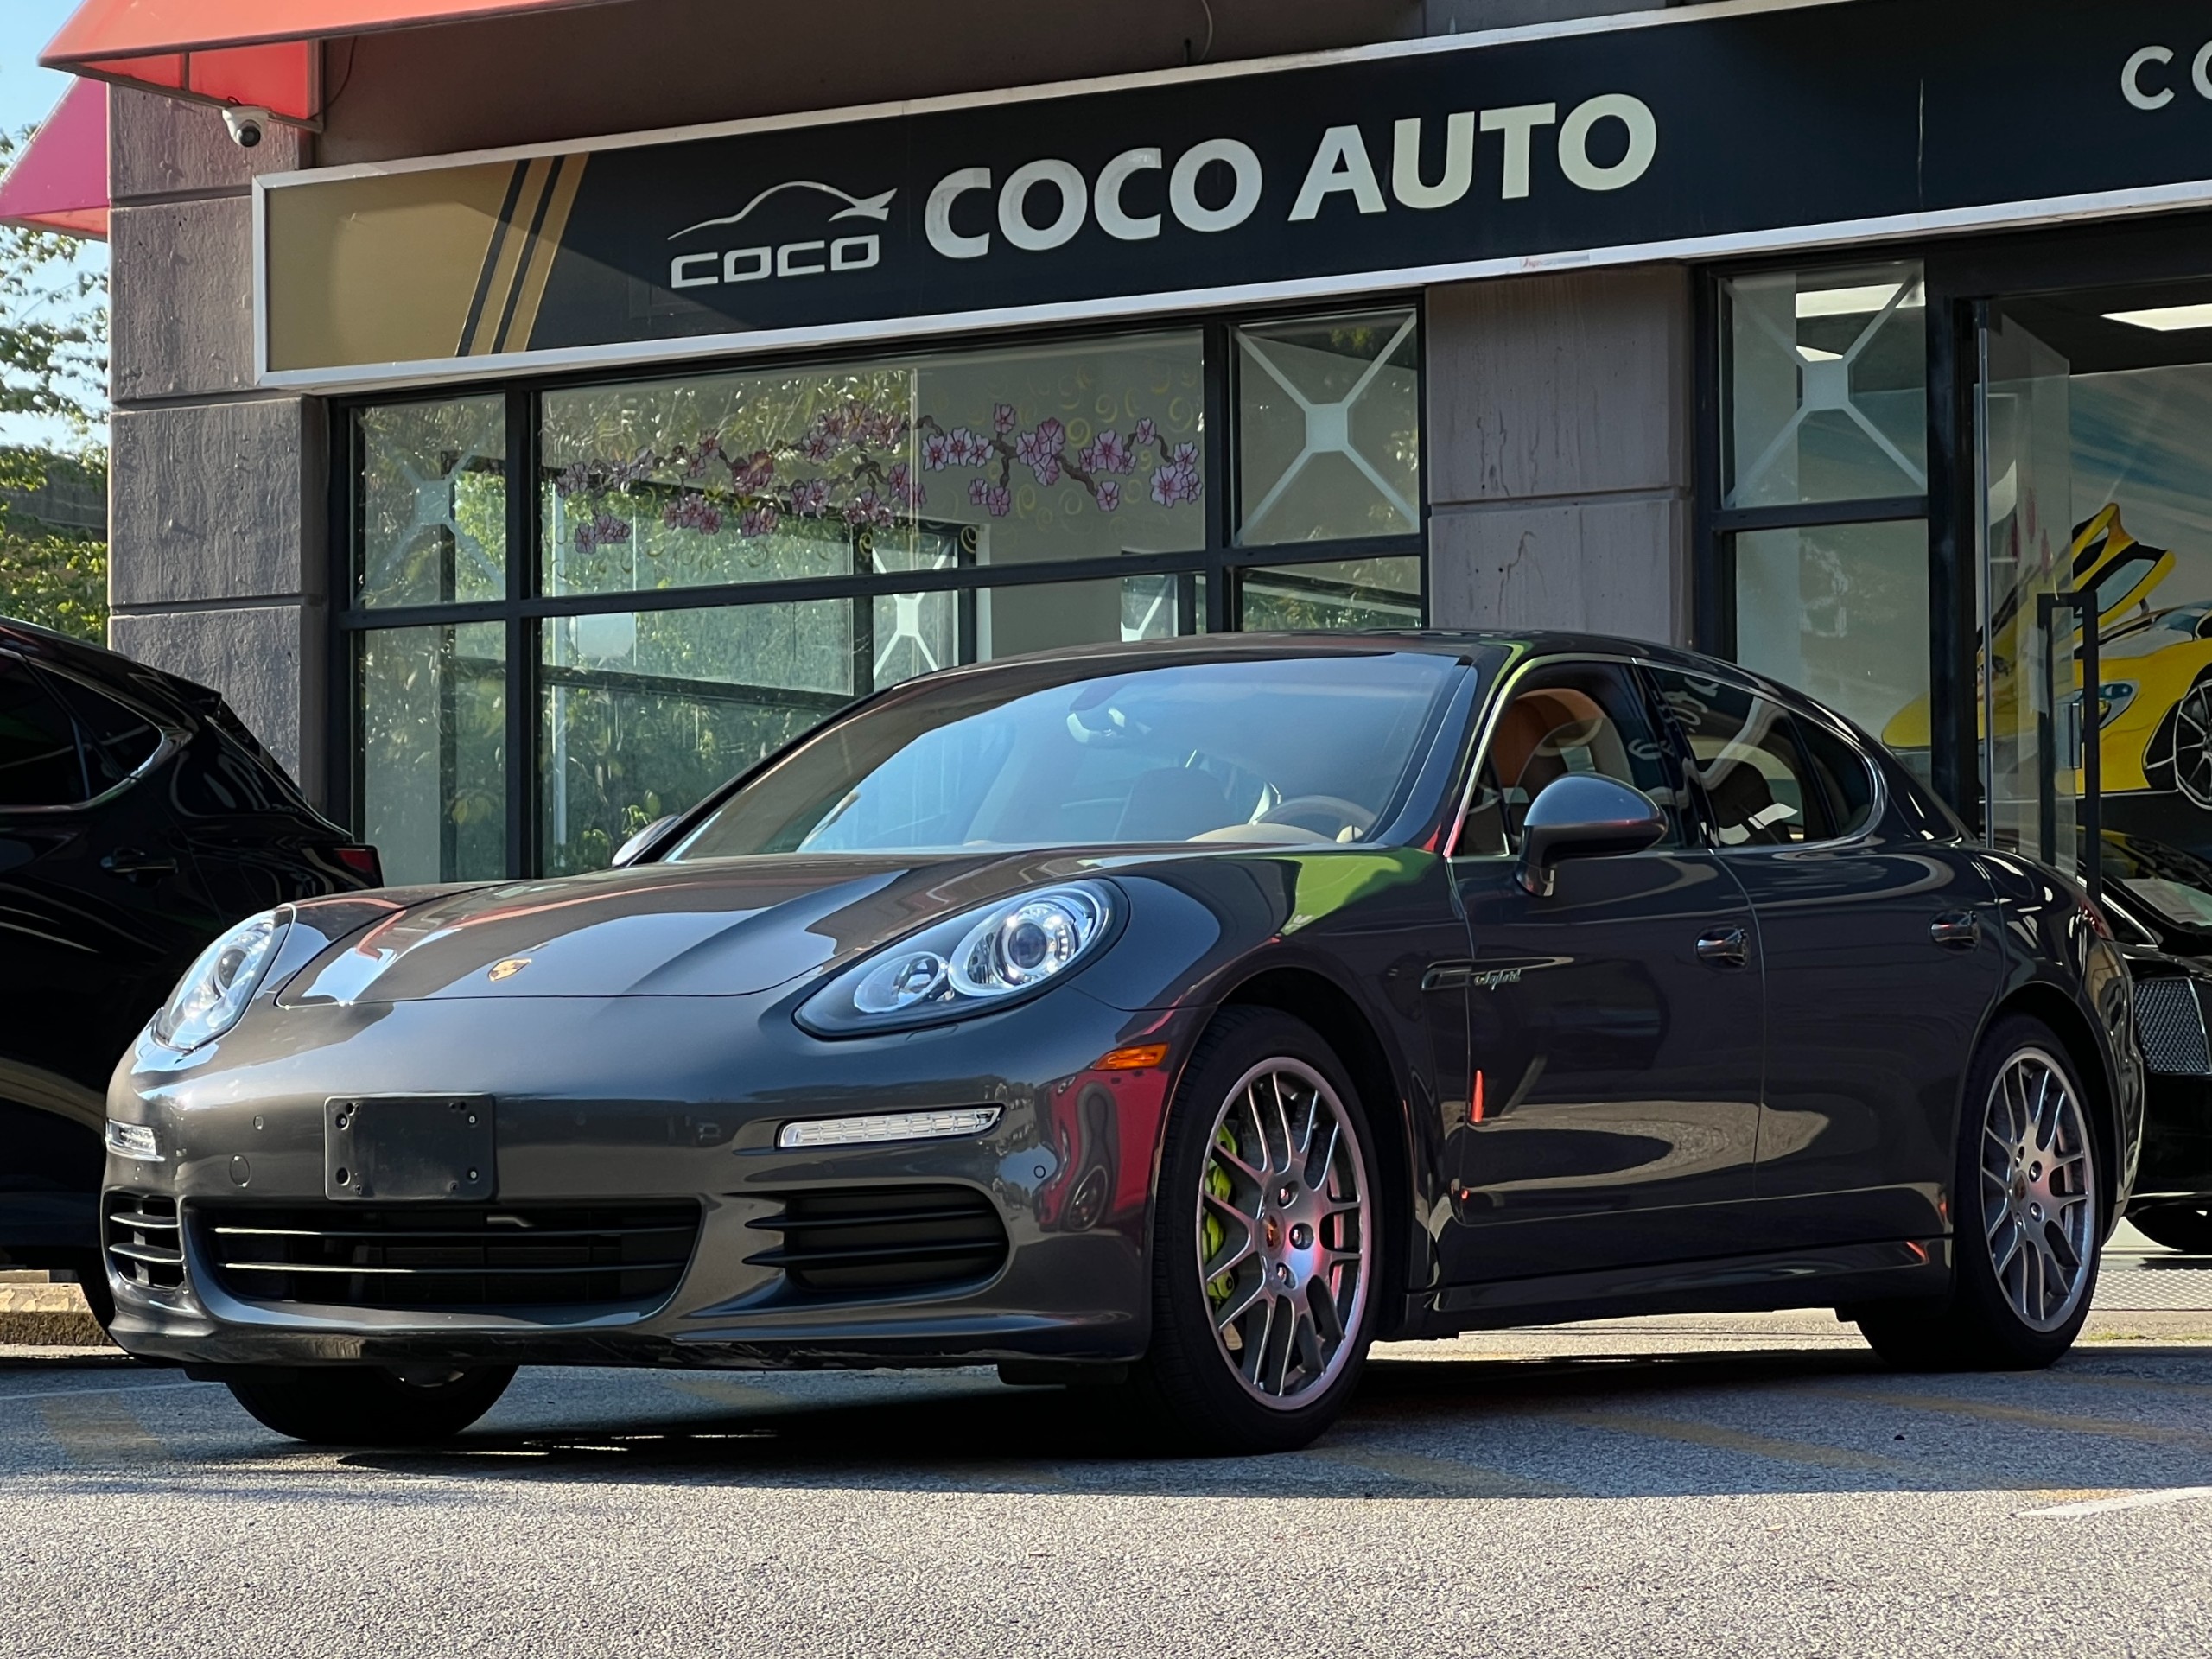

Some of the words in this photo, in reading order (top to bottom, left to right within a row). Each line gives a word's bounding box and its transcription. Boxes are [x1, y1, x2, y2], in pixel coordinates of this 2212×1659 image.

[925, 138, 1262, 259] COCO
[1288, 93, 1657, 222] AUTO
[671, 235, 880, 289] COCO
